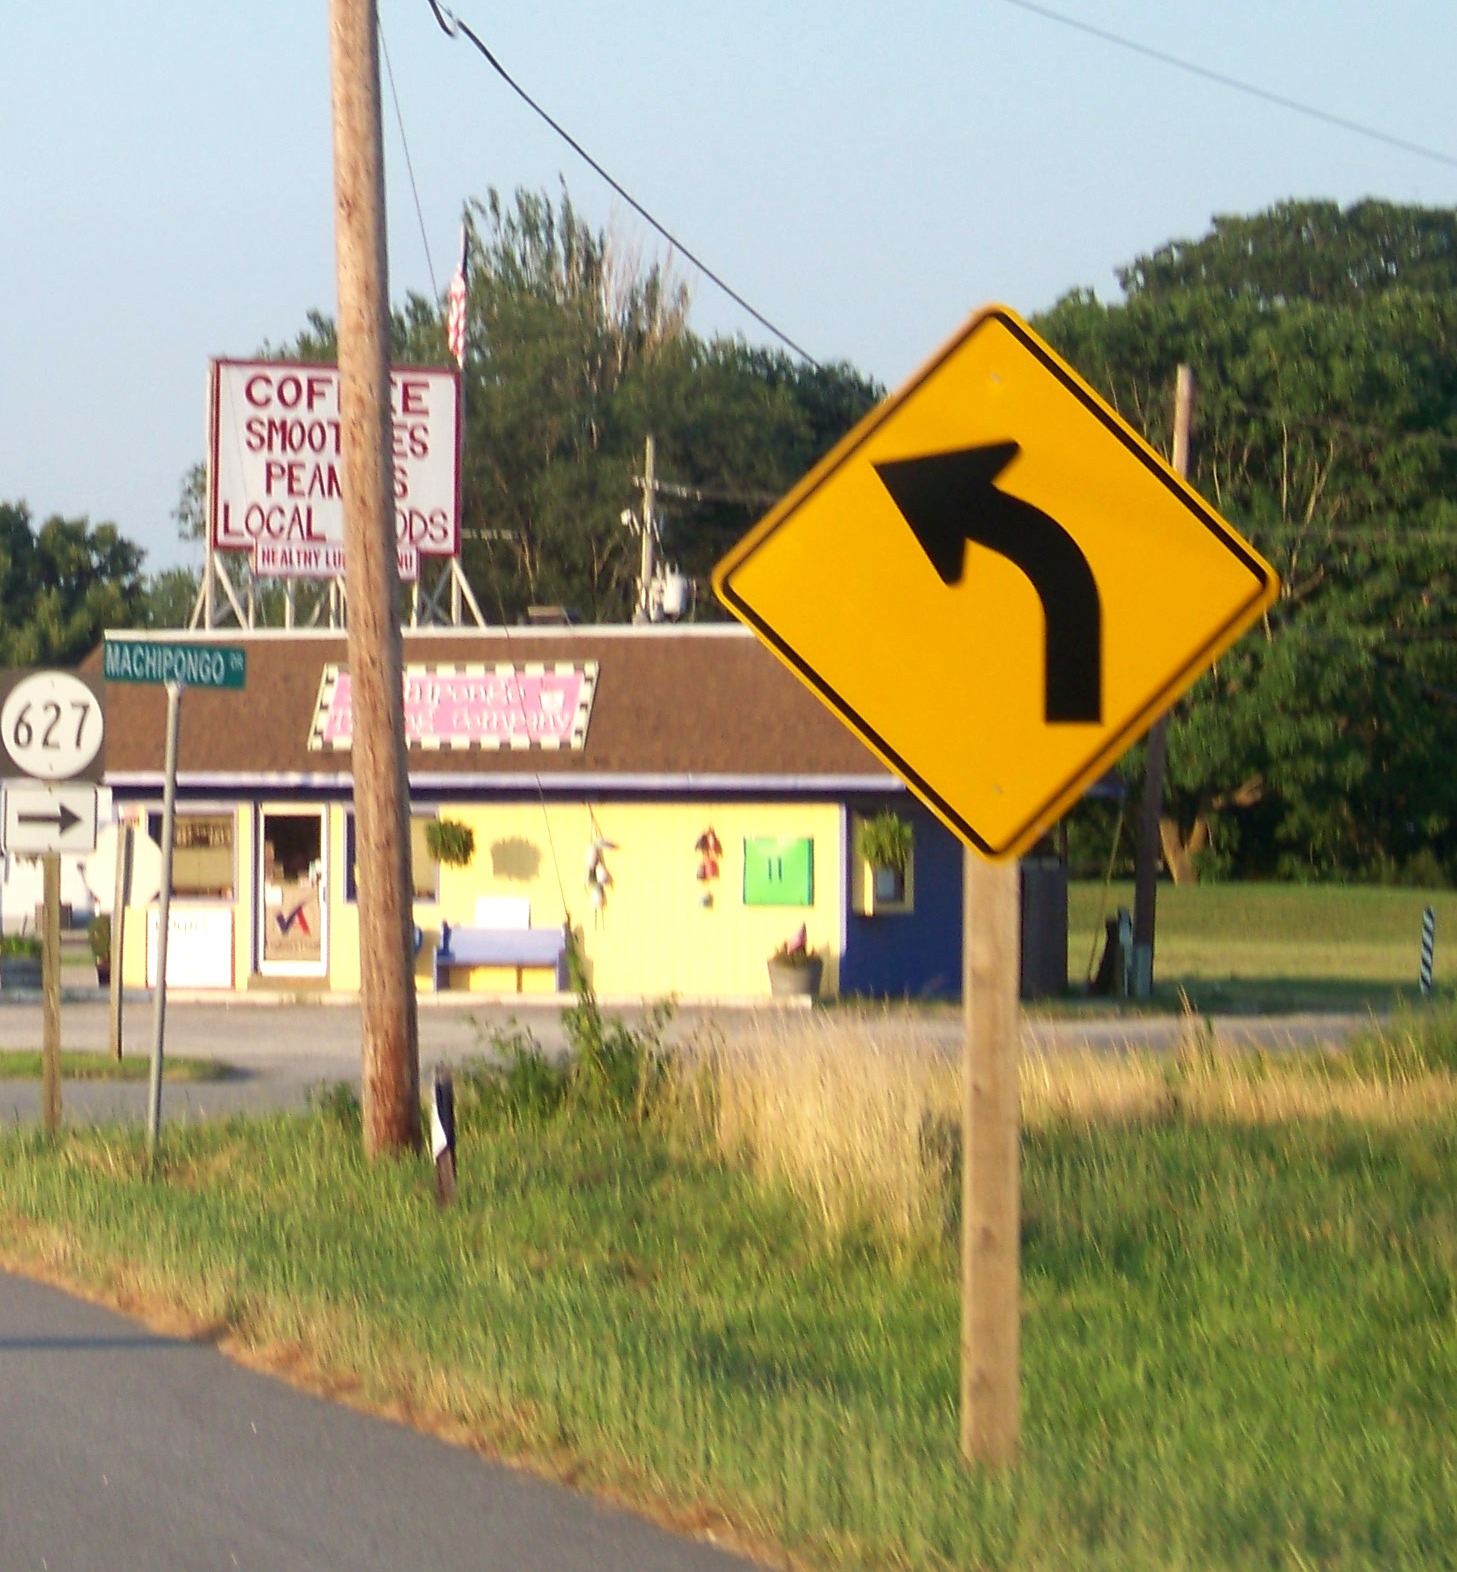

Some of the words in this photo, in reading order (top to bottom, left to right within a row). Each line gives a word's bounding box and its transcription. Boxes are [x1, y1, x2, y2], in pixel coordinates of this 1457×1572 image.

[245, 374, 430, 416] COFE
[245, 416, 429, 458] SMOOTES
[265, 460, 408, 499] PEANS
[223, 501, 327, 543] LOCAL
[392, 507, 449, 544] ODS
[105, 642, 226, 685] MACHIPONGO
[13, 701, 91, 751] 627
